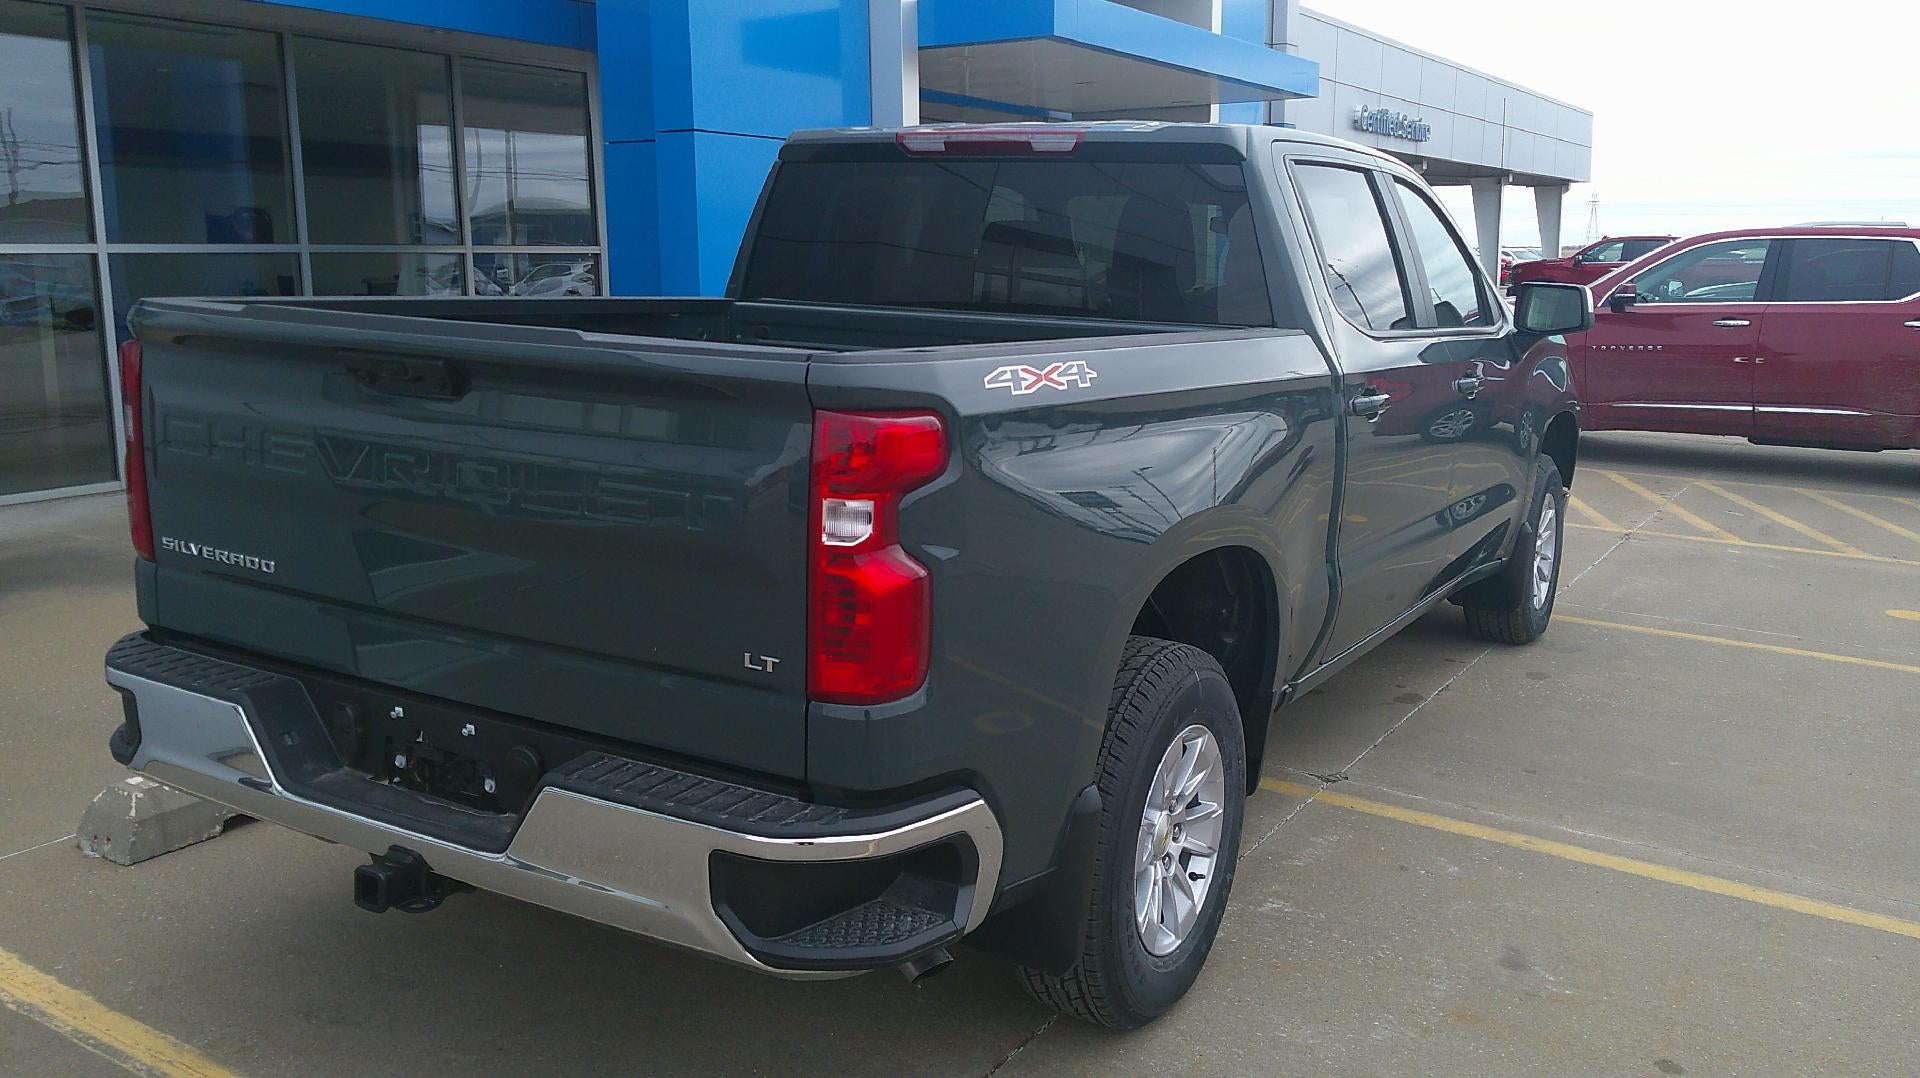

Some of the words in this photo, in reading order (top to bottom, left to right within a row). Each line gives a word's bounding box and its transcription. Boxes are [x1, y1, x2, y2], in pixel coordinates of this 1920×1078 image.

[1361, 104, 1400, 137] Certified
[1401, 114, 1431, 142] Service
[1592, 344, 1664, 352] TRAVERSE
[161, 413, 738, 531] CHEVROLET
[161, 536, 276, 574] SILVERADO
[744, 652, 781, 673] LT
